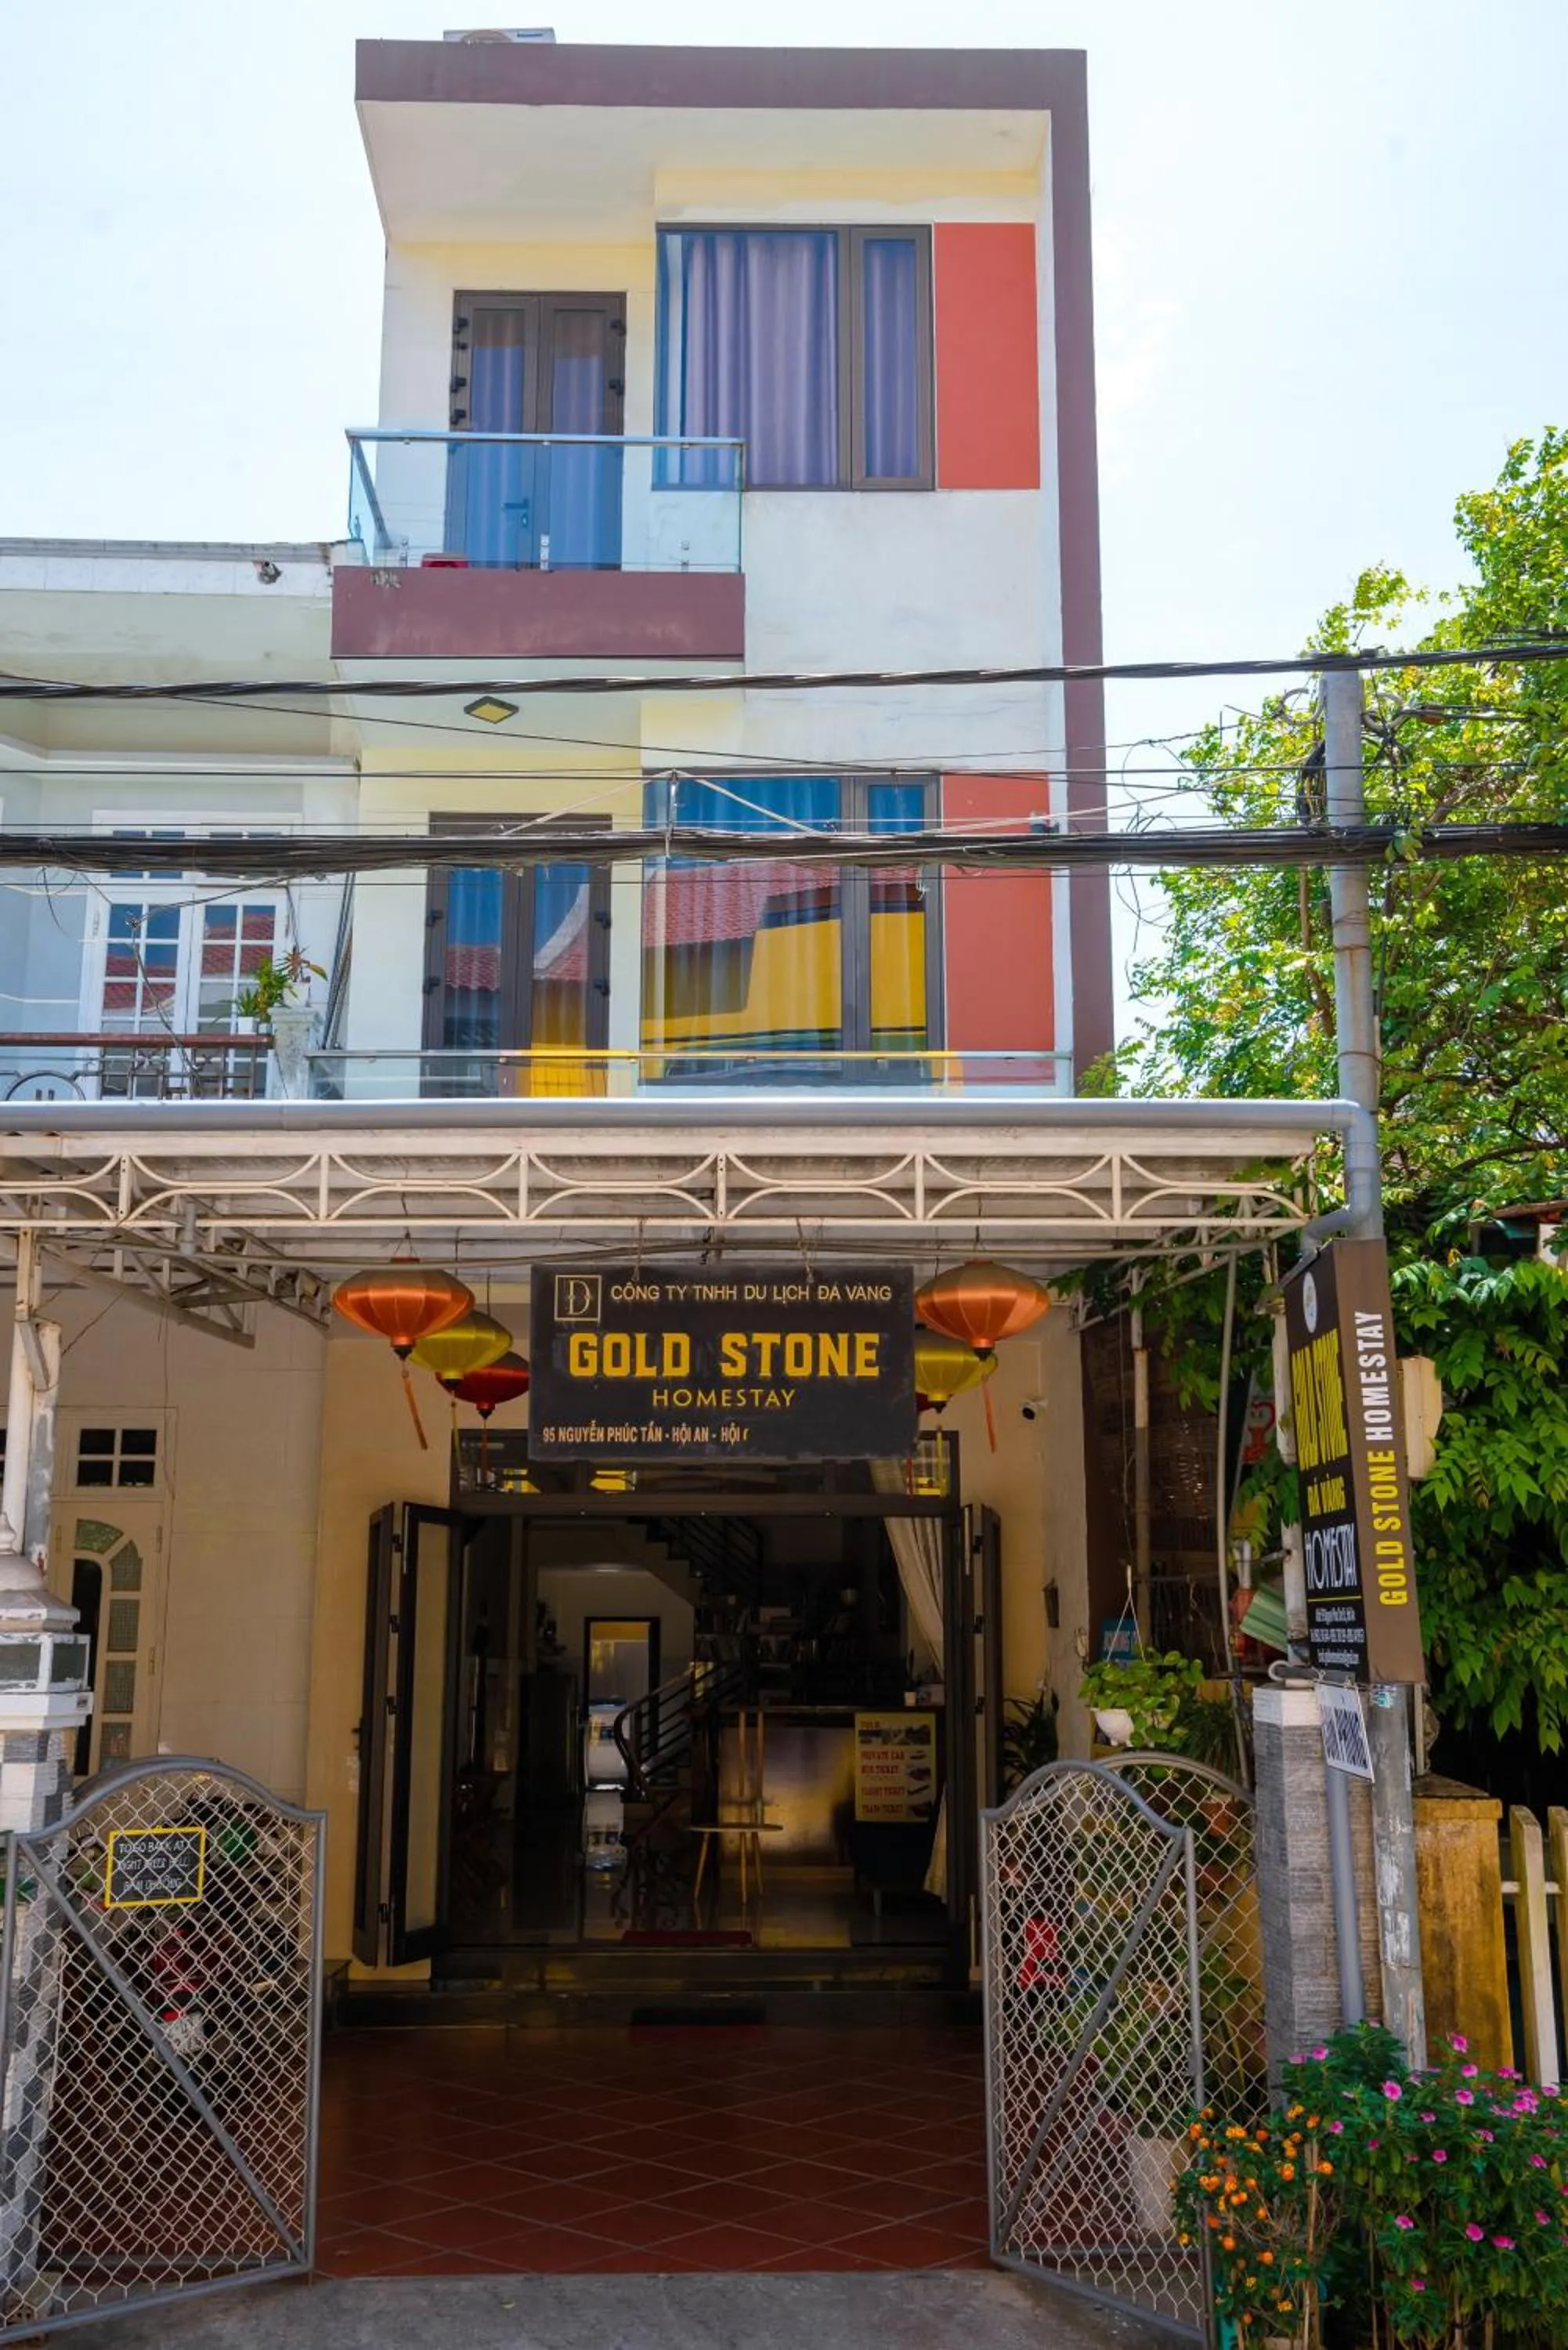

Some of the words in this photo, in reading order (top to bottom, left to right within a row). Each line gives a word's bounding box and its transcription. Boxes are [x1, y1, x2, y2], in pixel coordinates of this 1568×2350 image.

[611, 1282, 659, 1300] CÔNG
[666, 1285, 687, 1300] TY
[693, 1285, 737, 1300] TNHH
[745, 1285, 767, 1300] DU
[773, 1285, 810, 1303] LỊCH
[569, 1332, 690, 1377] GOLD
[721, 1332, 880, 1377] STONE
[1354, 1311, 1393, 1441] HOMESTAY
[652, 1389, 796, 1407] HOMESTAY
[607, 1422, 638, 1442] PHÚC
[672, 1422, 691, 1447] HỘI
[693, 1426, 709, 1442] AN
[721, 1422, 740, 1447] HỘI
[1367, 1450, 1401, 1531] STONE
[1375, 1541, 1408, 1605] GOLD
